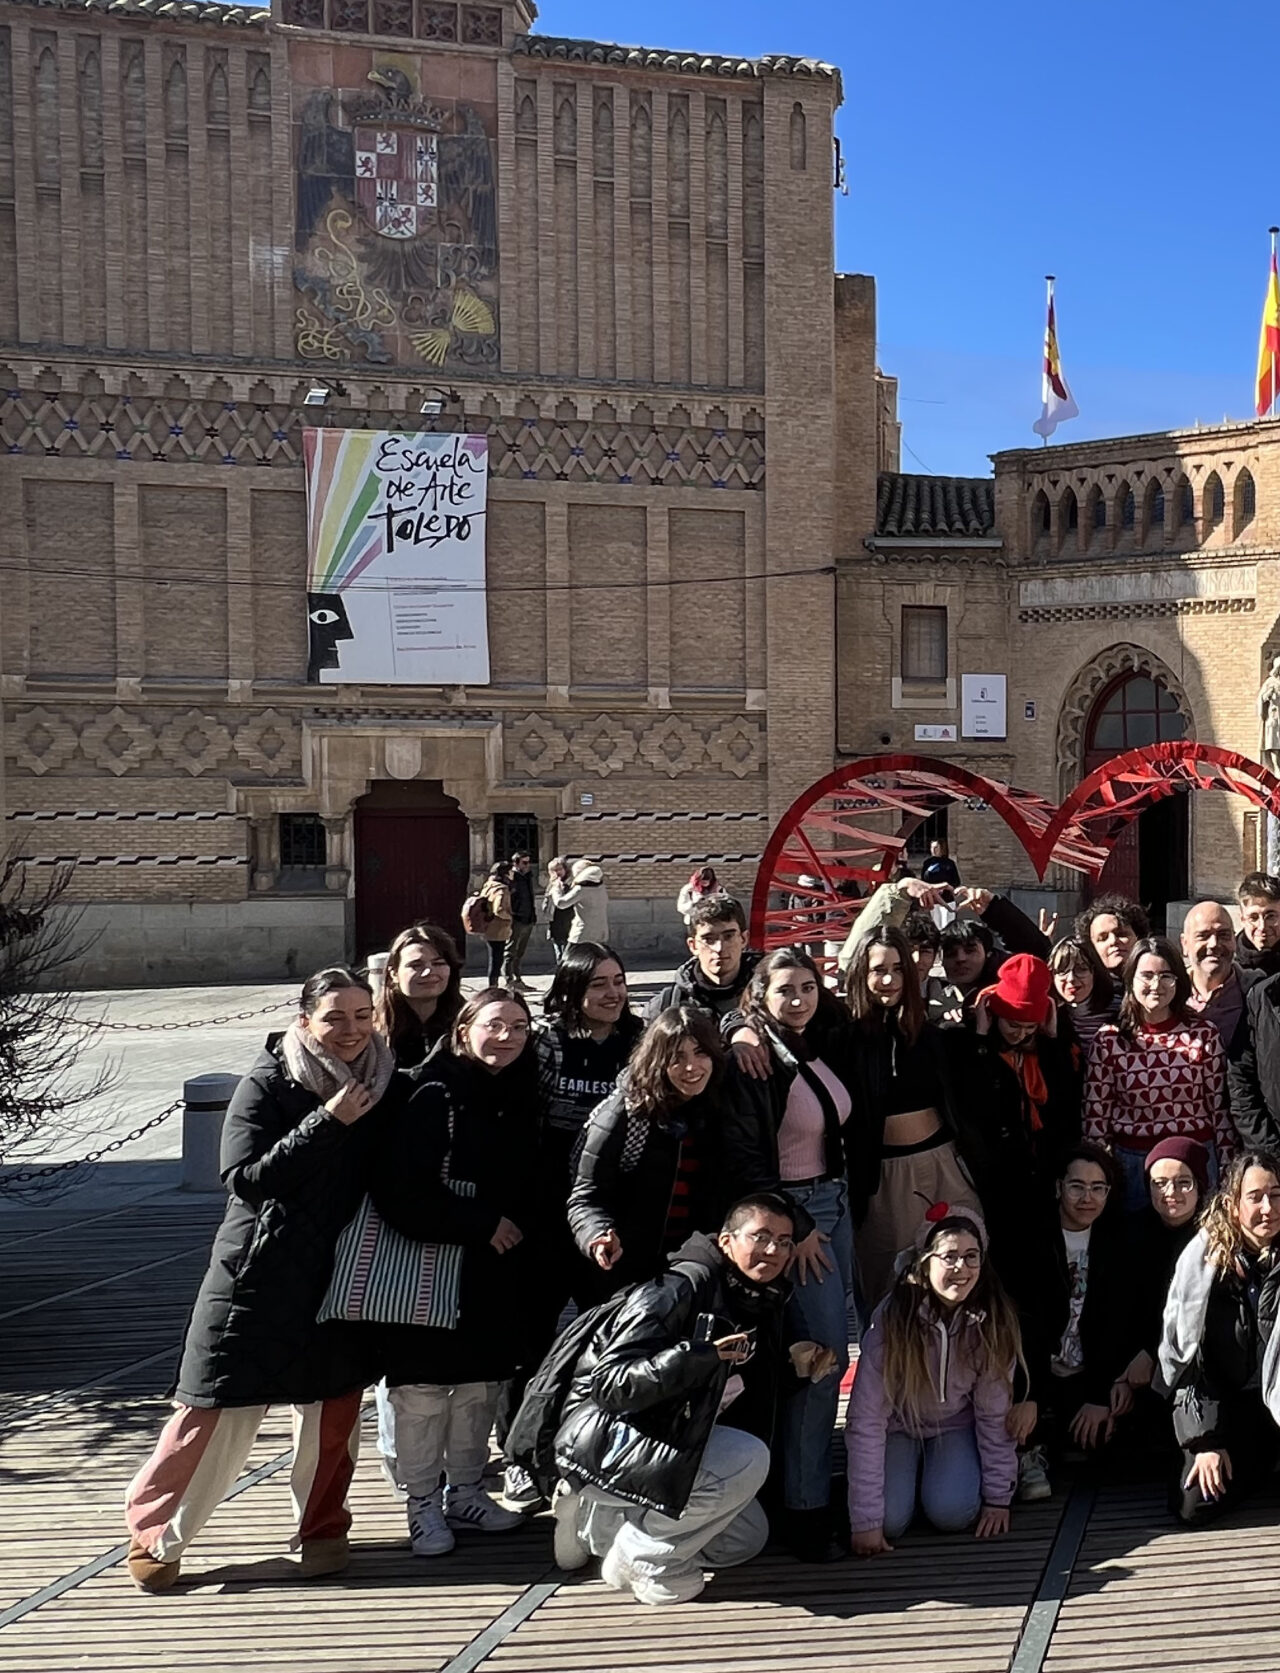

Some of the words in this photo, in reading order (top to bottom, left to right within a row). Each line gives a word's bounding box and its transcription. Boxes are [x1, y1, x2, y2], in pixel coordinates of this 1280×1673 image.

[376, 437, 485, 478] Escuela
[386, 475, 416, 501] de
[417, 471, 475, 511] Arte
[559, 1077, 617, 1094] EARLESS
